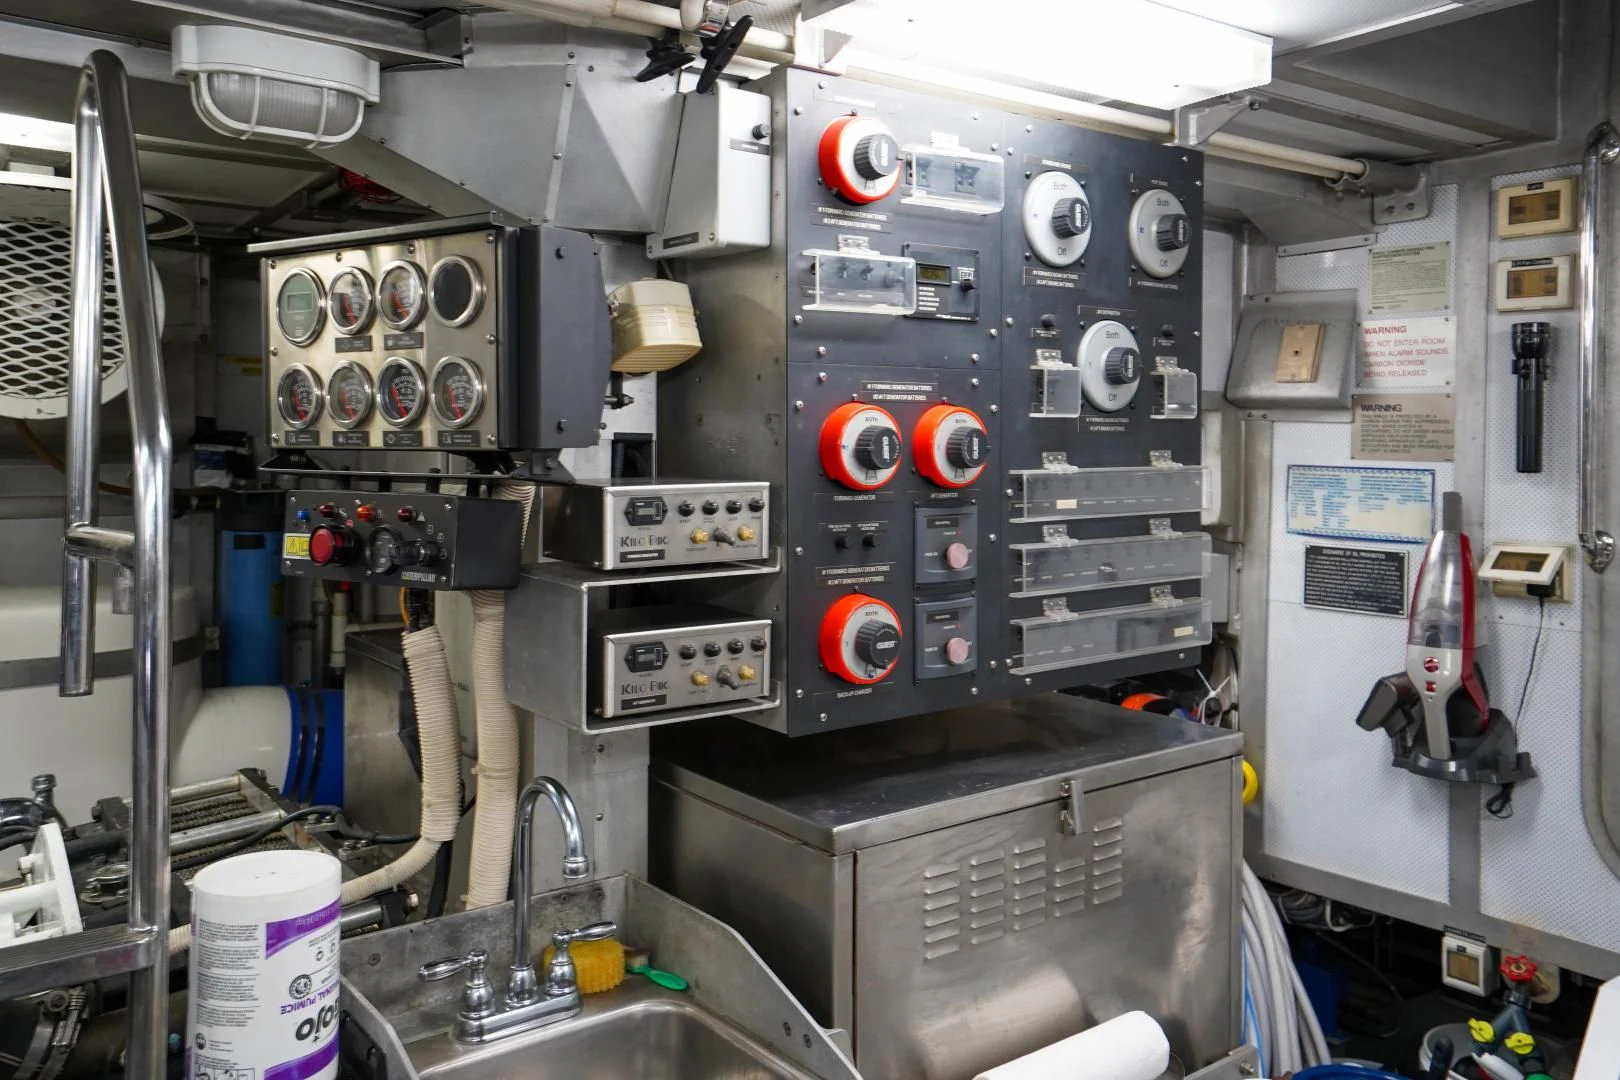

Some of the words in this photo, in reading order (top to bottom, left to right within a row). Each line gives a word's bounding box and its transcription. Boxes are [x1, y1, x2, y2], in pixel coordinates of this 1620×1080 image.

[1156, 197, 1169, 207] Both
[1057, 247, 1067, 256] Off
[1106, 330, 1120, 339] Both
[1363, 325, 1407, 335] WARNING
[1377, 340, 1392, 348] NOT
[1388, 349, 1413, 357] ALARM
[1415, 348, 1449, 356] SOUNDS
[1363, 360, 1394, 368] CARBON
[1388, 369, 1428, 377] RELEASED
[1360, 403, 1402, 412] WARNING
[401, 571, 436, 583] CATERPILLAR
[280, 996, 317, 1015] PUMICE
